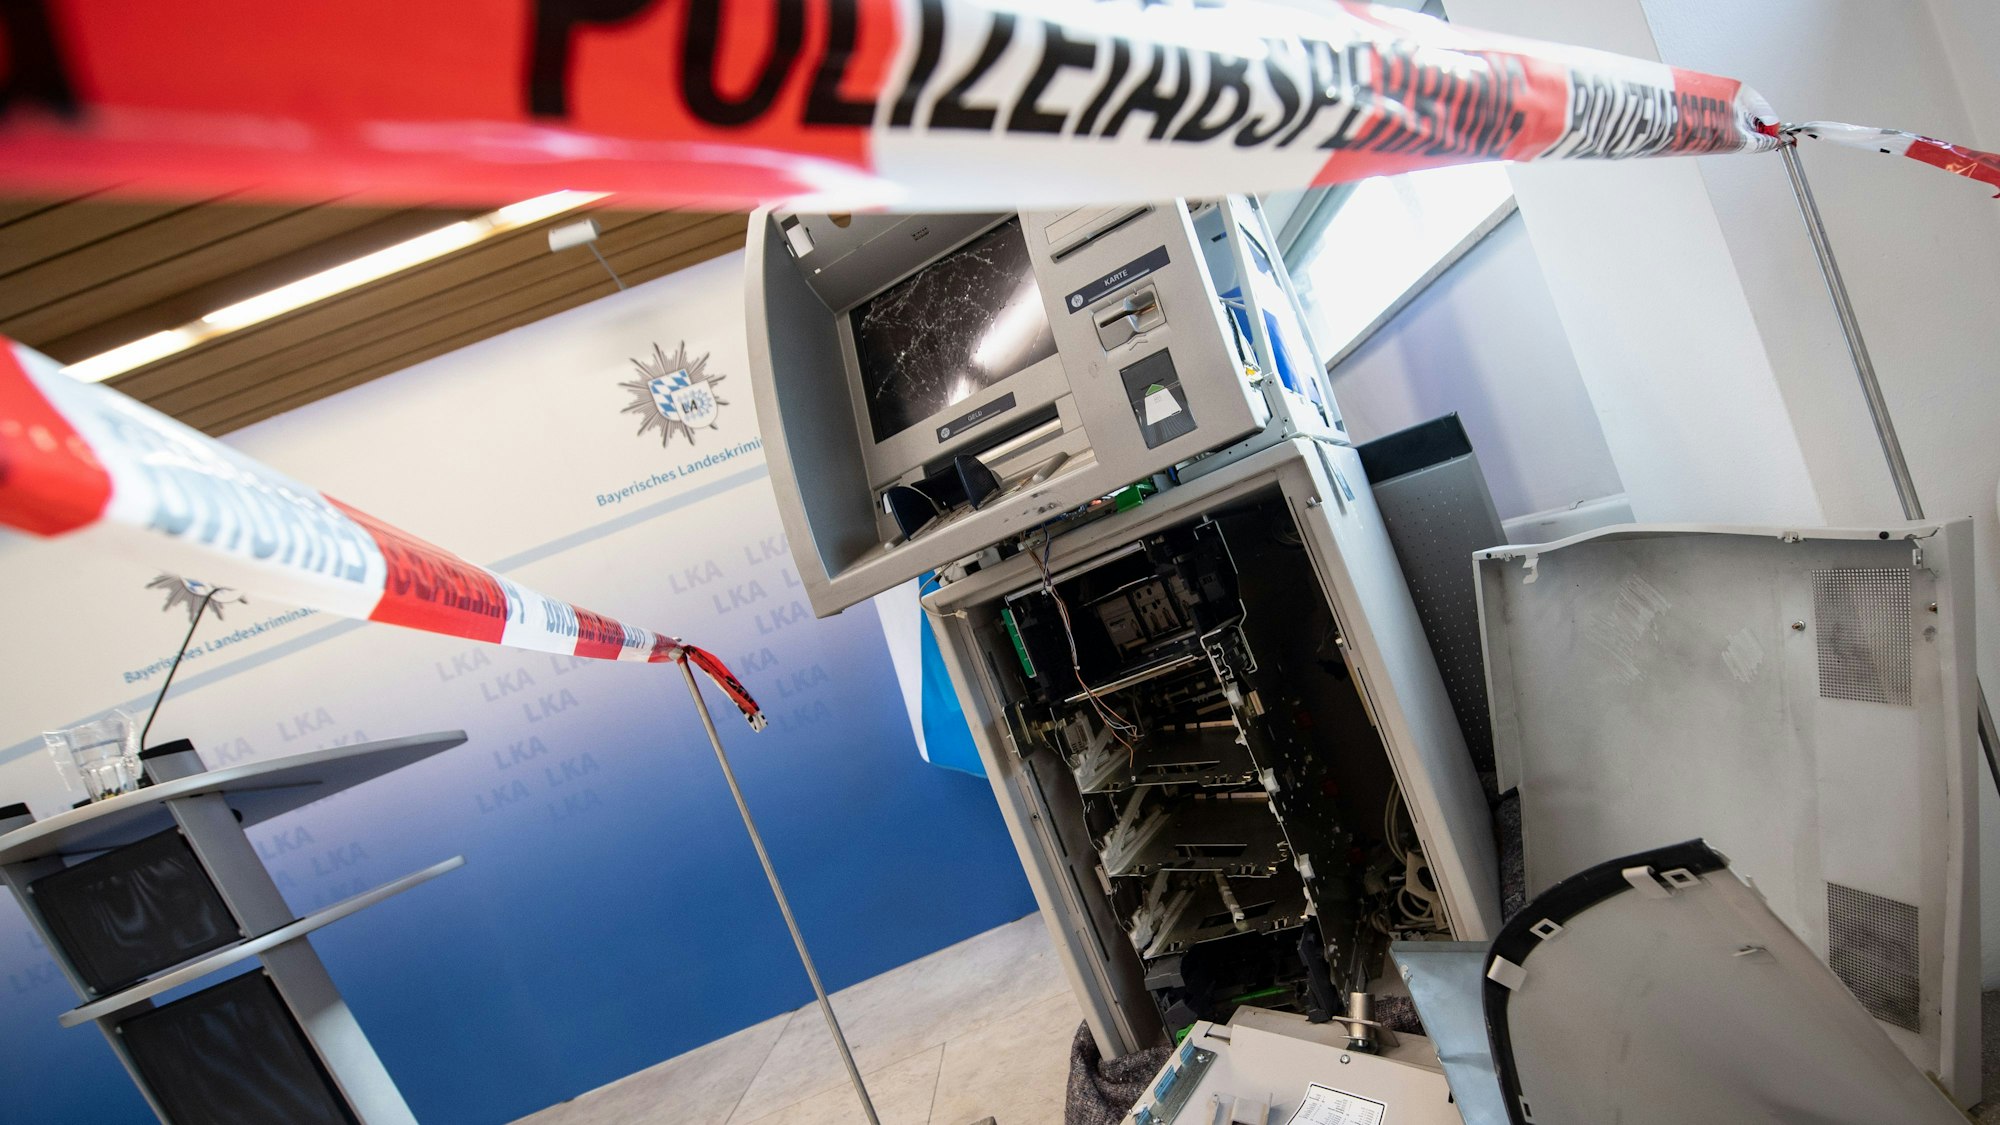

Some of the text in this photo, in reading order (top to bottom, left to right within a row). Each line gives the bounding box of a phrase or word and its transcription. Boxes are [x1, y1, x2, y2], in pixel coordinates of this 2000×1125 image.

[1103, 269, 1129, 287] KARTE
[596, 470, 677, 507] Bayerisches
[668, 559, 724, 595] LKA
[712, 579, 768, 616] LKA
[754, 600, 810, 635] LKA
[435, 646, 492, 682] LKA
[775, 663, 830, 698] LKA
[480, 666, 536, 702] LKA
[523, 688, 579, 723] LKA
[276, 706, 336, 743] LKA
[493, 736, 549, 771] LKA
[545, 752, 600, 787] LKA
[475, 779, 530, 814] LKA
[258, 826, 315, 861] LKA
[311, 842, 369, 877] LKA
